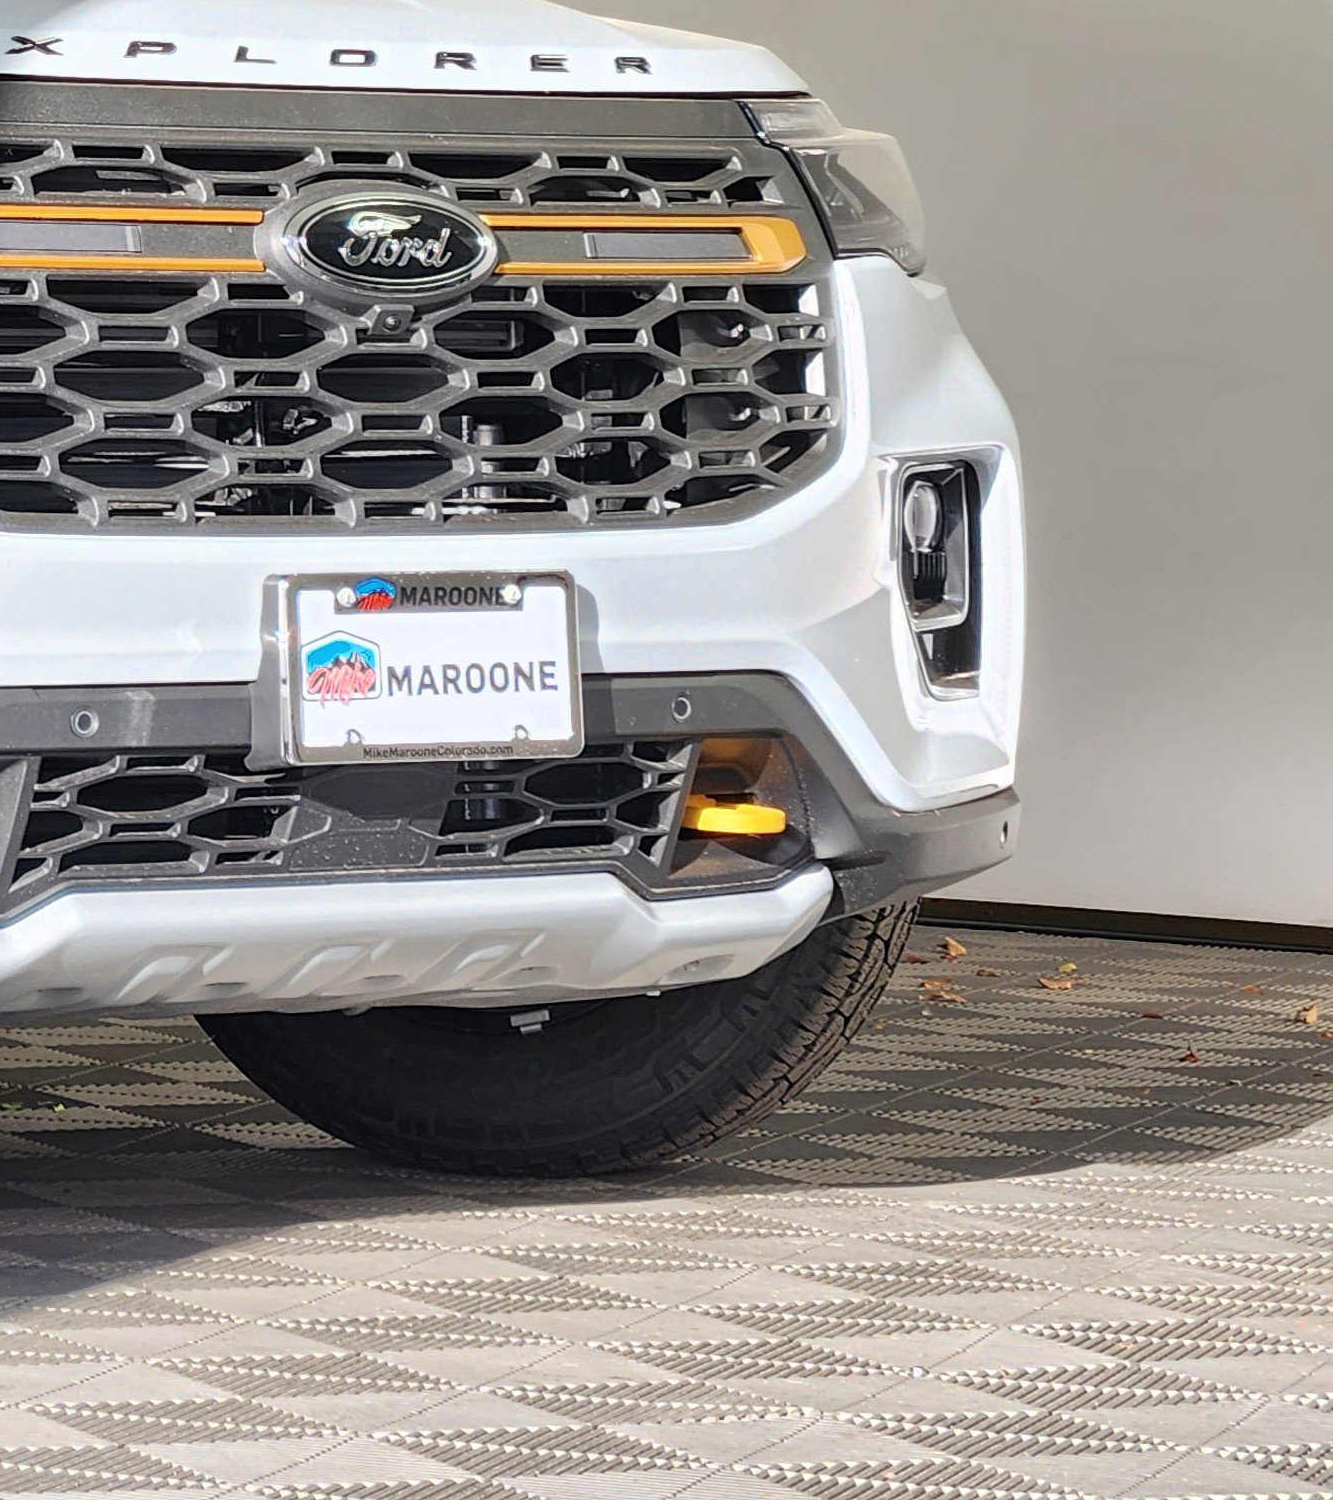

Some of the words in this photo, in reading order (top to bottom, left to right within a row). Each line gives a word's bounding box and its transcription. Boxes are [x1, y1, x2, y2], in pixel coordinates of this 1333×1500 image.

[337, 211, 452, 268] Ford
[387, 661, 558, 697] MAROONE
[362, 744, 514, 760] MikeMarooneColorado.com
